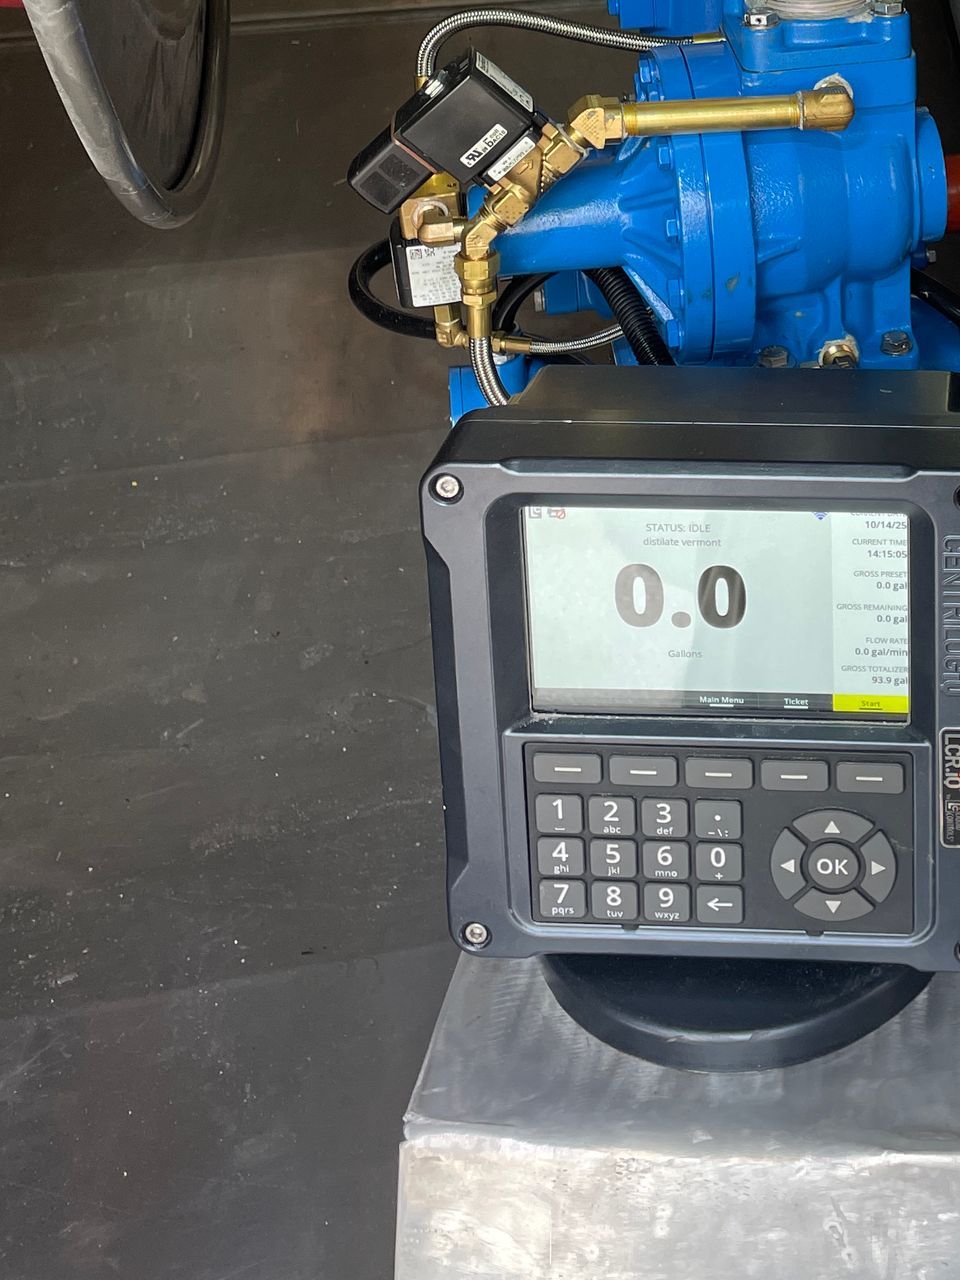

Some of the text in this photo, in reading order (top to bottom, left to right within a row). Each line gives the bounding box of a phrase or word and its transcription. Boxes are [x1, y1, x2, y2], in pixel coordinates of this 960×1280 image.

[646, 523, 711, 533] STATUS: IDLE
[865, 520, 907, 530] 10/14/25
[681, 538, 722, 548] vermont
[852, 538, 907, 547] CURRENT TIME
[867, 549, 907, 559] 14:15:05
[853, 570, 907, 578] GROSS PRESET
[876, 581, 907, 592] 0.0 gal
[615, 563, 747, 629] 0.0
[836, 603, 908, 612] GROSS REMAINING
[876, 614, 908, 625] 0.0 gal
[889, 637, 908, 645] RATE
[668, 649, 703, 659] Gallons
[855, 647, 908, 658] 0.0 gal/min
[841, 665, 909, 673] GROSS TOTALIZER
[871, 676, 908, 686] 93.9 gal
[699, 695, 745, 705] Main Menu
[783, 697, 809, 706] Ticket
[552, 798, 563, 820] 1
[603, 801, 619, 822] 2
[656, 803, 672, 823] 3
[603, 825, 621, 835] abc
[656, 826, 674, 835] def
[552, 841, 568, 862] 4
[605, 843, 621, 864] 5
[657, 845, 673, 866] 6
[710, 847, 726, 868] 0
[553, 864, 569, 875] ghi
[607, 866, 620, 876] jkl
[816, 858, 848, 875] OK
[553, 884, 569, 904] 7
[606, 886, 622, 906] 8
[658, 888, 674, 908] 9
[551, 907, 574, 916] pqrs
[606, 910, 623, 918] tuv
[654, 912, 679, 921] wxyz
